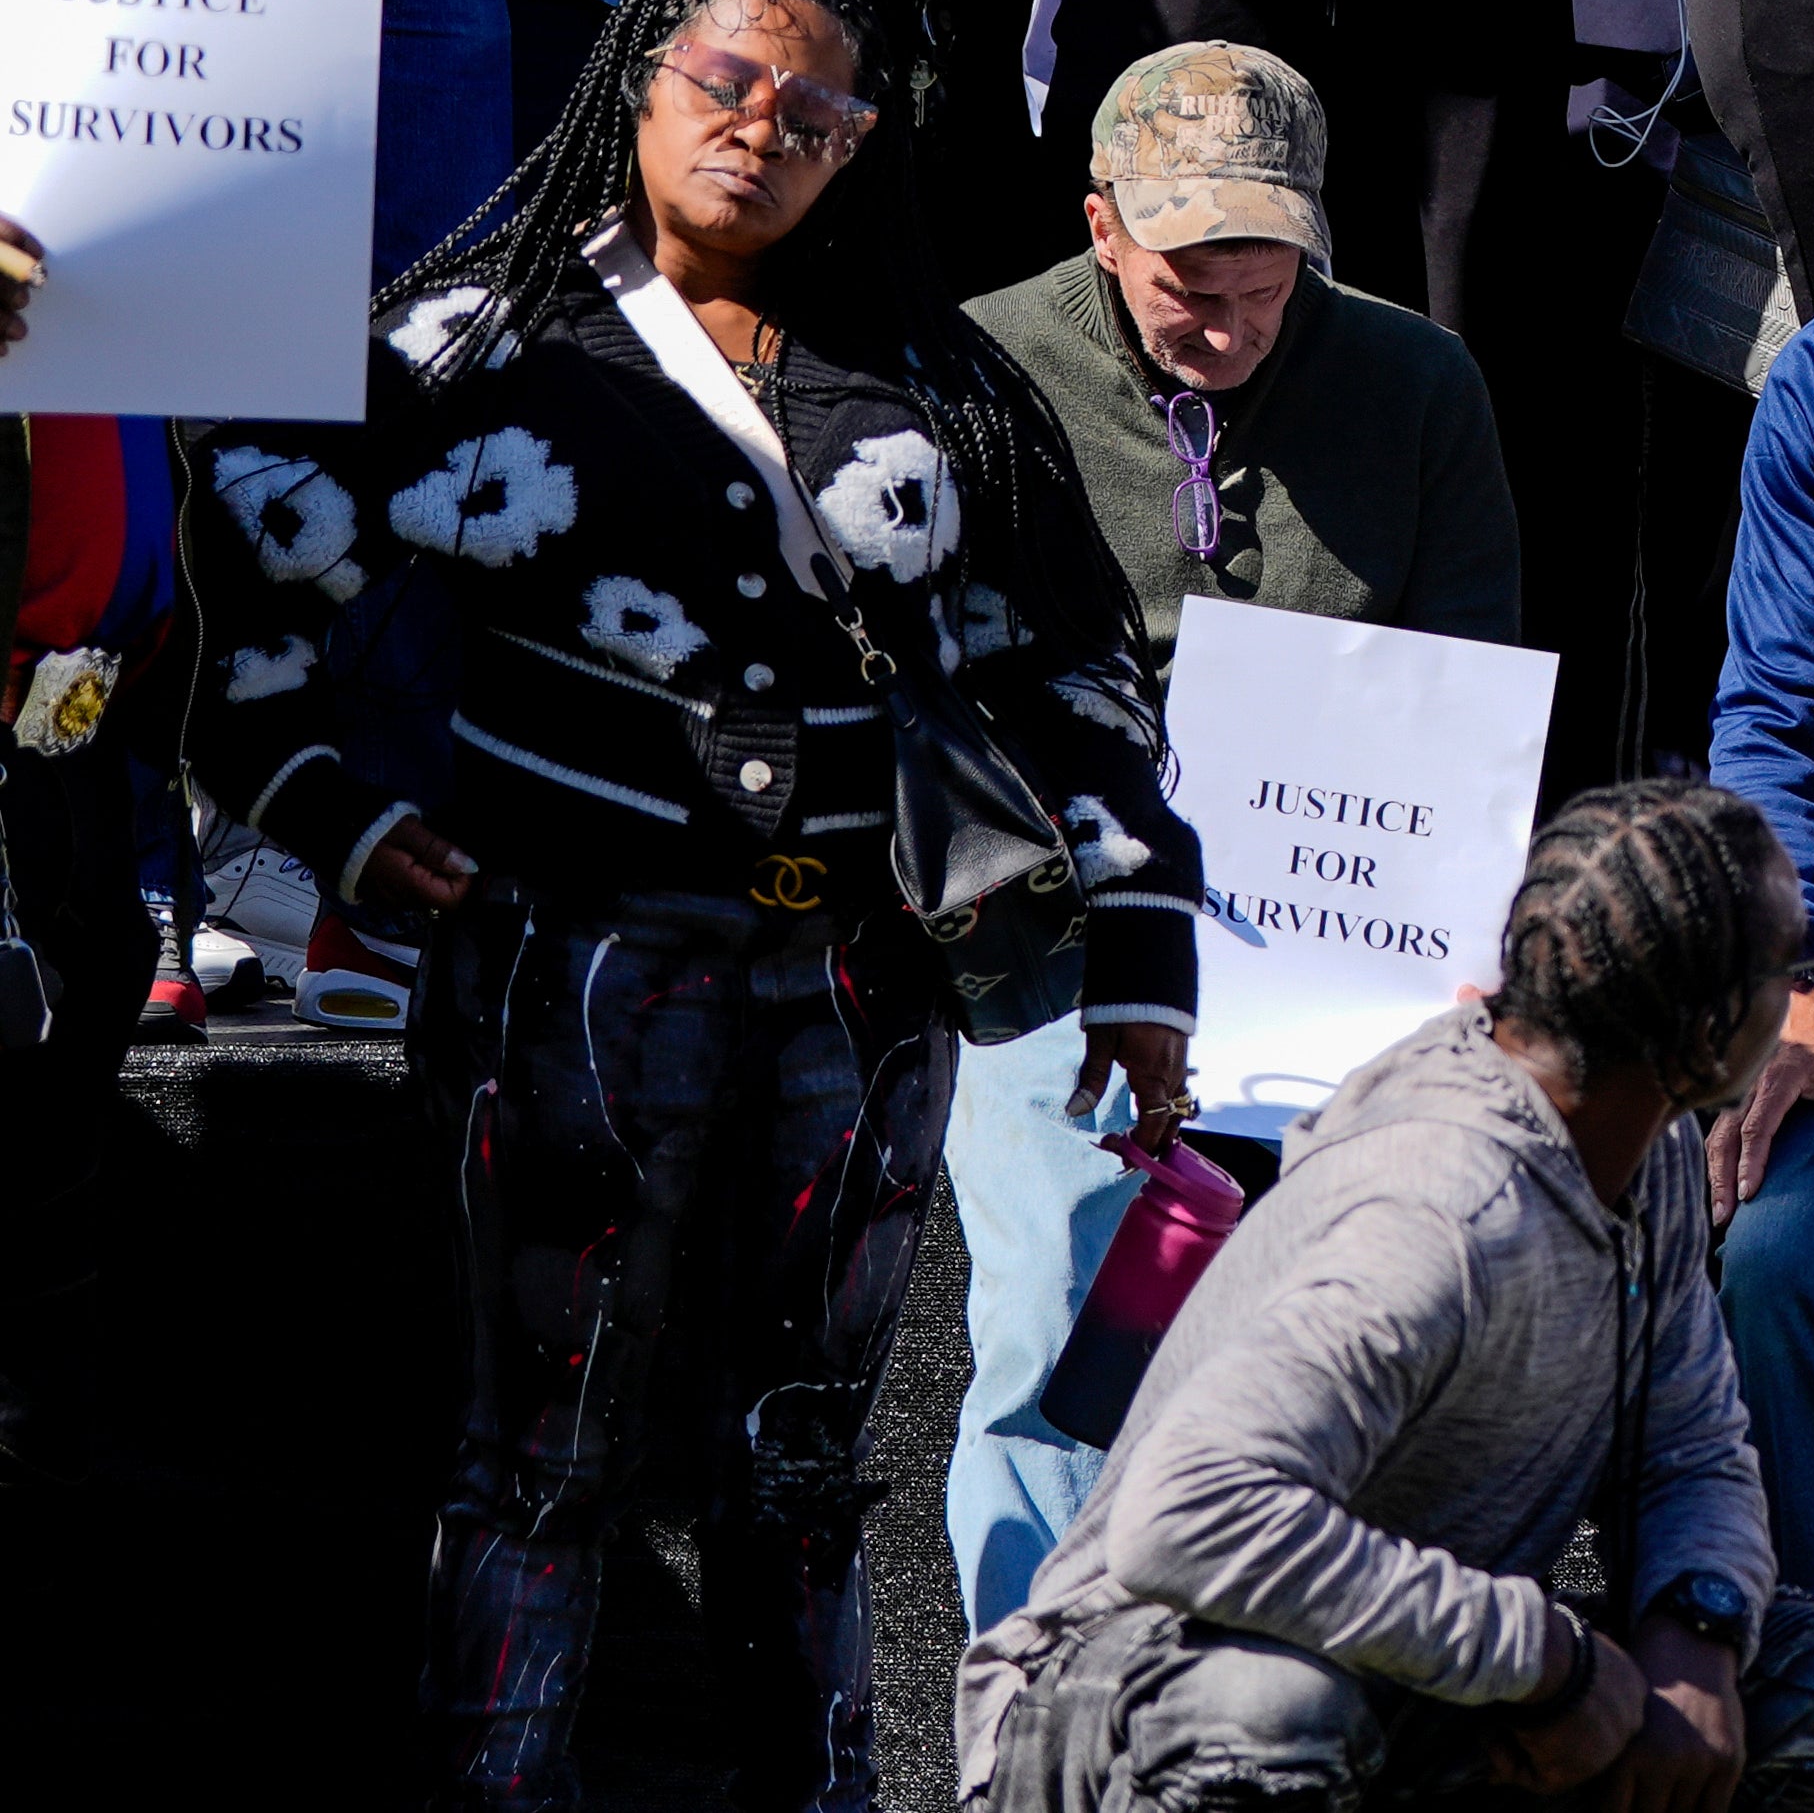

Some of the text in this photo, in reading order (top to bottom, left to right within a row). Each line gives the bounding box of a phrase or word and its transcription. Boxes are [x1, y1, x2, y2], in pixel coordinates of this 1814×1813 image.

[104, 40, 207, 81] FOR
[8, 100, 304, 153] SURVIVORS
[1250, 781, 1432, 836] JUSTICE
[1290, 846, 1376, 888] FOR
[1202, 886, 1450, 962] SURVIVORS
